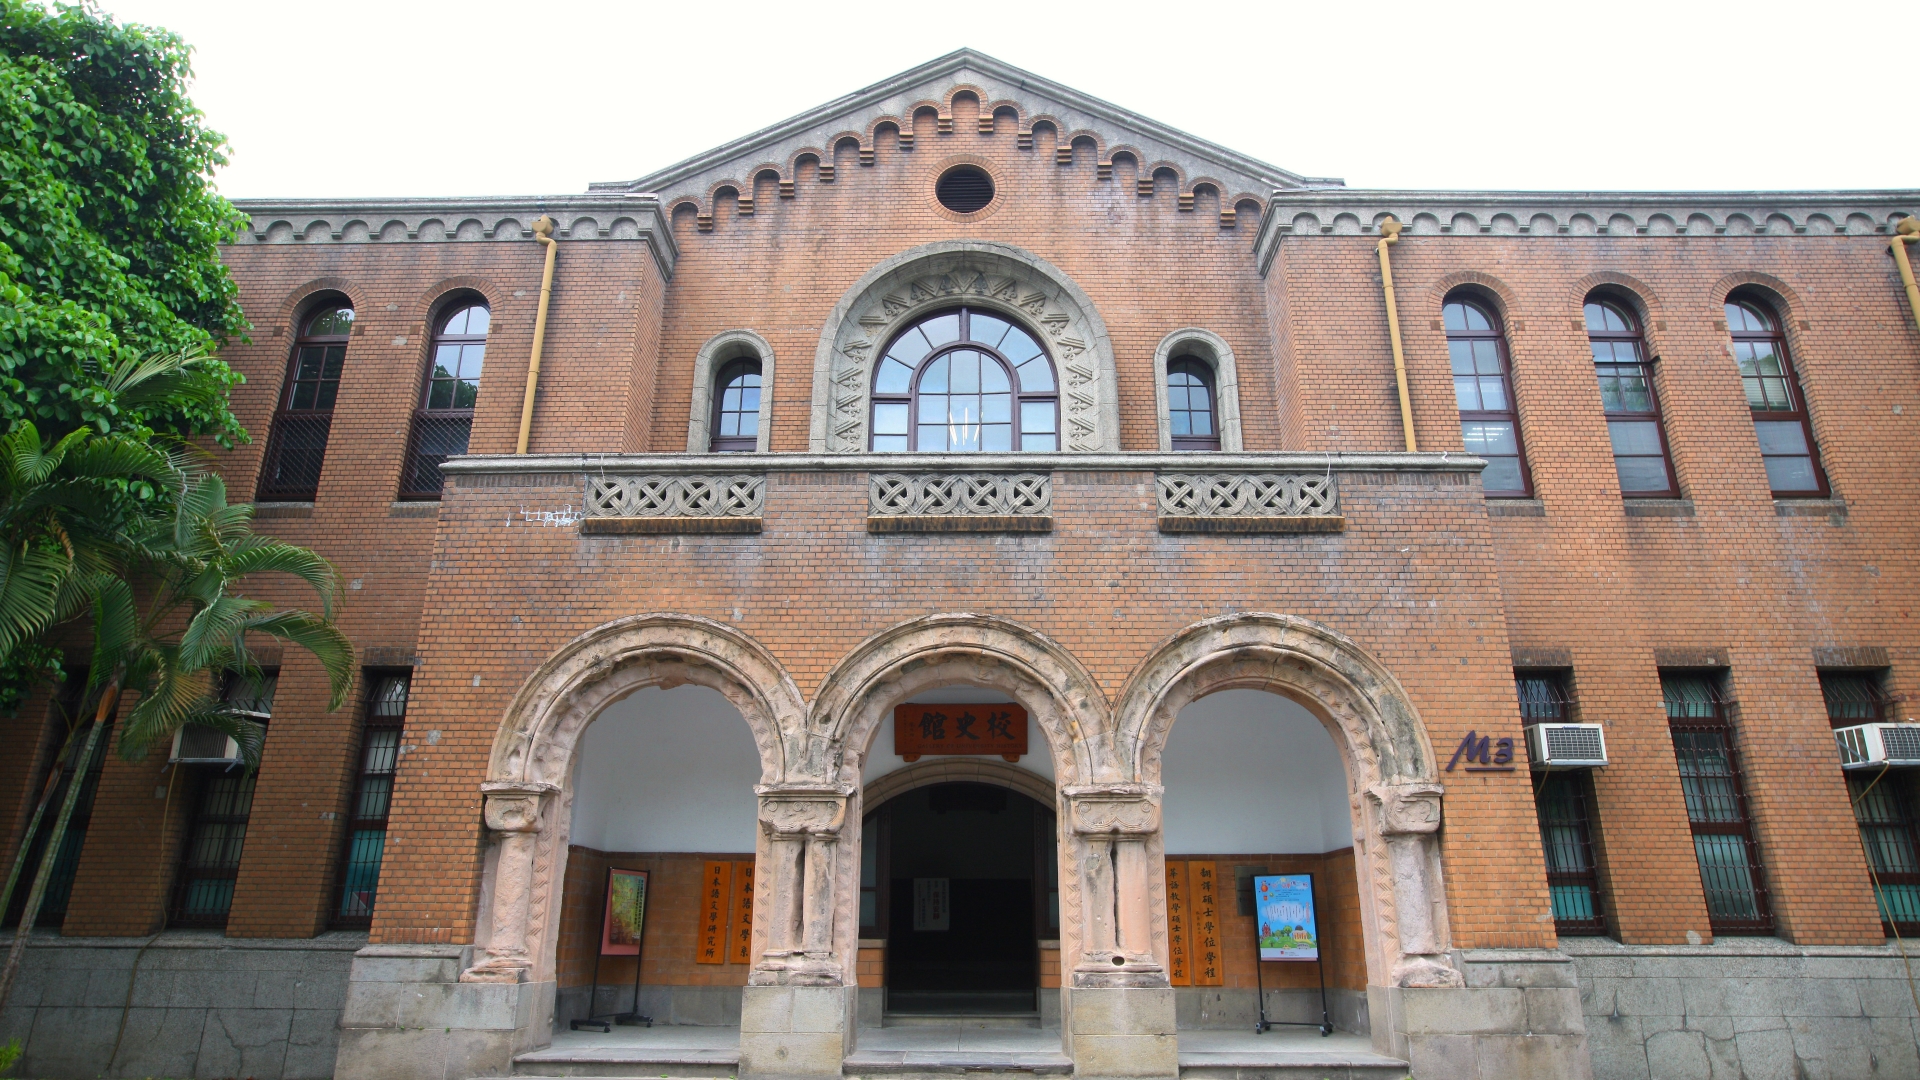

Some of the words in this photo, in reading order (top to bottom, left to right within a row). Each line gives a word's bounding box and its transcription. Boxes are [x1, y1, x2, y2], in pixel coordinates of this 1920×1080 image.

[917, 711, 1016, 740] 校史館
[1446, 729, 1514, 772] M3
[705, 867, 721, 958] 日本語文學研究所
[740, 868, 753, 957] 日本語文學系
[1169, 867, 1183, 978] 華語教學碩士學位學程
[1200, 867, 1216, 978] 翻譯碩士學位學程
